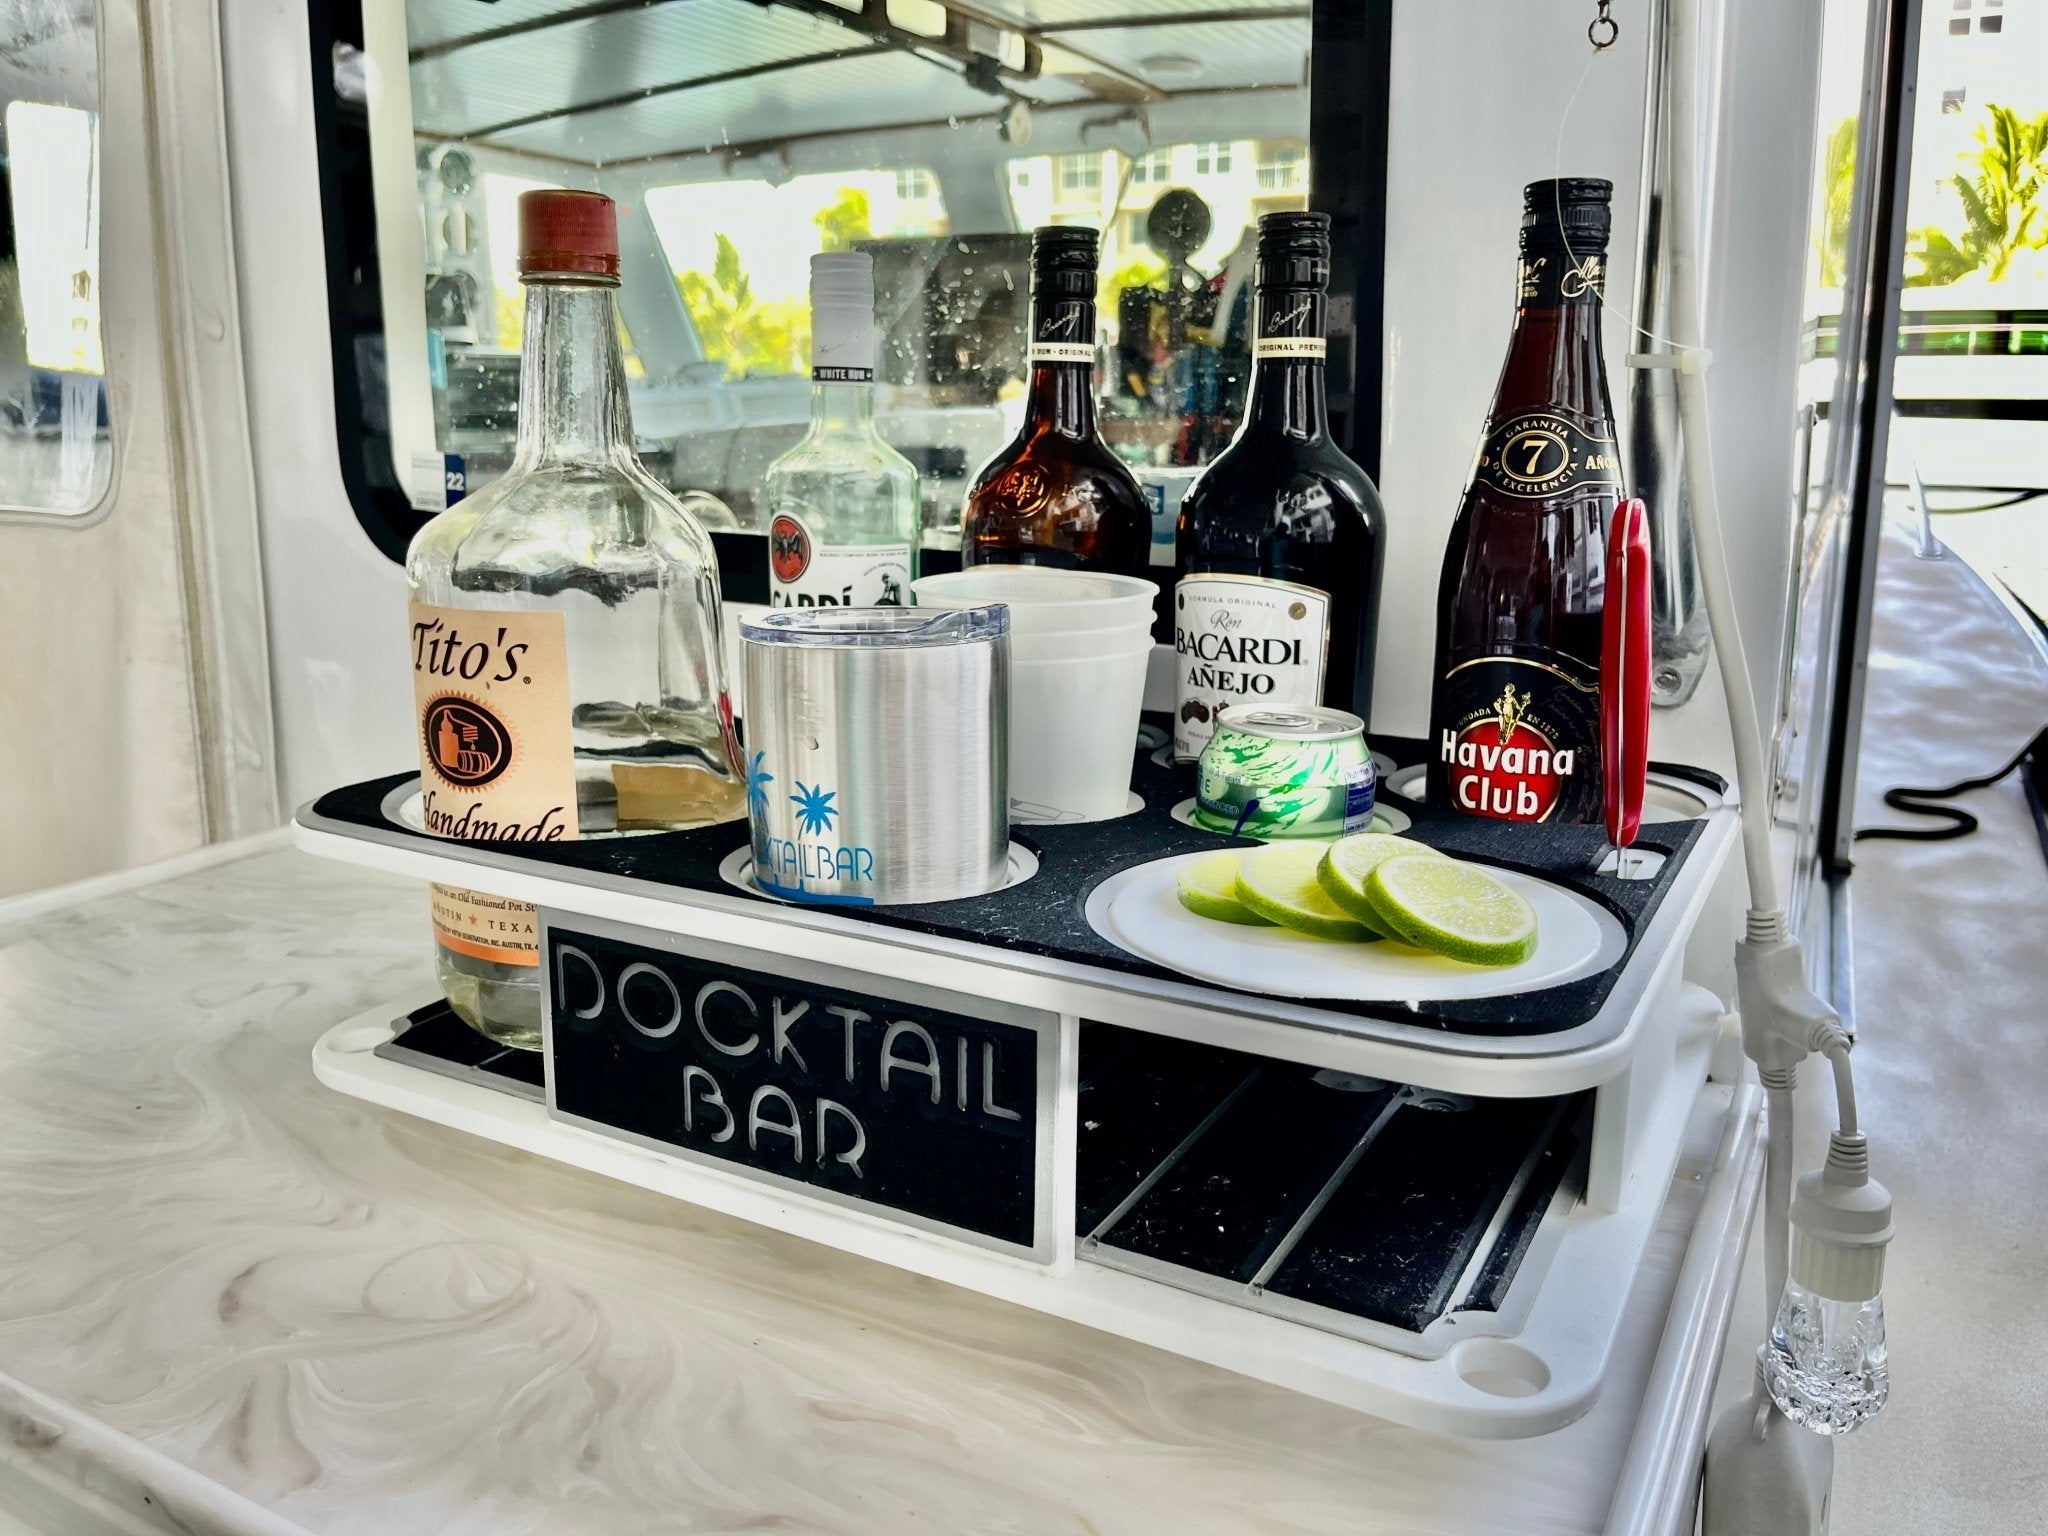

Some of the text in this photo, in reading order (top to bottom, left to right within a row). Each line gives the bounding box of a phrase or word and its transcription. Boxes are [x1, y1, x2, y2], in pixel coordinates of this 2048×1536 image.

[1258, 343, 1294, 351] ORIGINAL
[820, 368, 865, 380] WHITE RUM
[1505, 420, 1570, 439] GARANTIA
[1522, 439, 1549, 475] 7
[446, 472, 465, 491] 22
[1492, 461, 1501, 477] DE
[1502, 461, 1579, 493] EXCELENCIA
[1188, 595, 1278, 610] FORMULA ORIGINAL
[1210, 609, 1242, 632] Ron
[413, 617, 529, 682] Tito's
[1176, 627, 1302, 666] BACARDI
[1187, 662, 1275, 695] AÑEJO
[1456, 707, 1492, 730] FUNDADA
[1526, 713, 1541, 725] EN
[1441, 728, 1575, 776] Havana
[1458, 774, 1540, 816] Club
[423, 790, 566, 841] Handmade
[433, 901, 462, 922] AUSTIN
[458, 891, 470, 903] Old
[471, 895, 506, 910] Fashioned
[508, 901, 522, 911] Pot
[502, 940, 524, 950] AUSTIN,
[556, 942, 1022, 1122] DOCKTAIL
[683, 1065, 864, 1179] BAR
